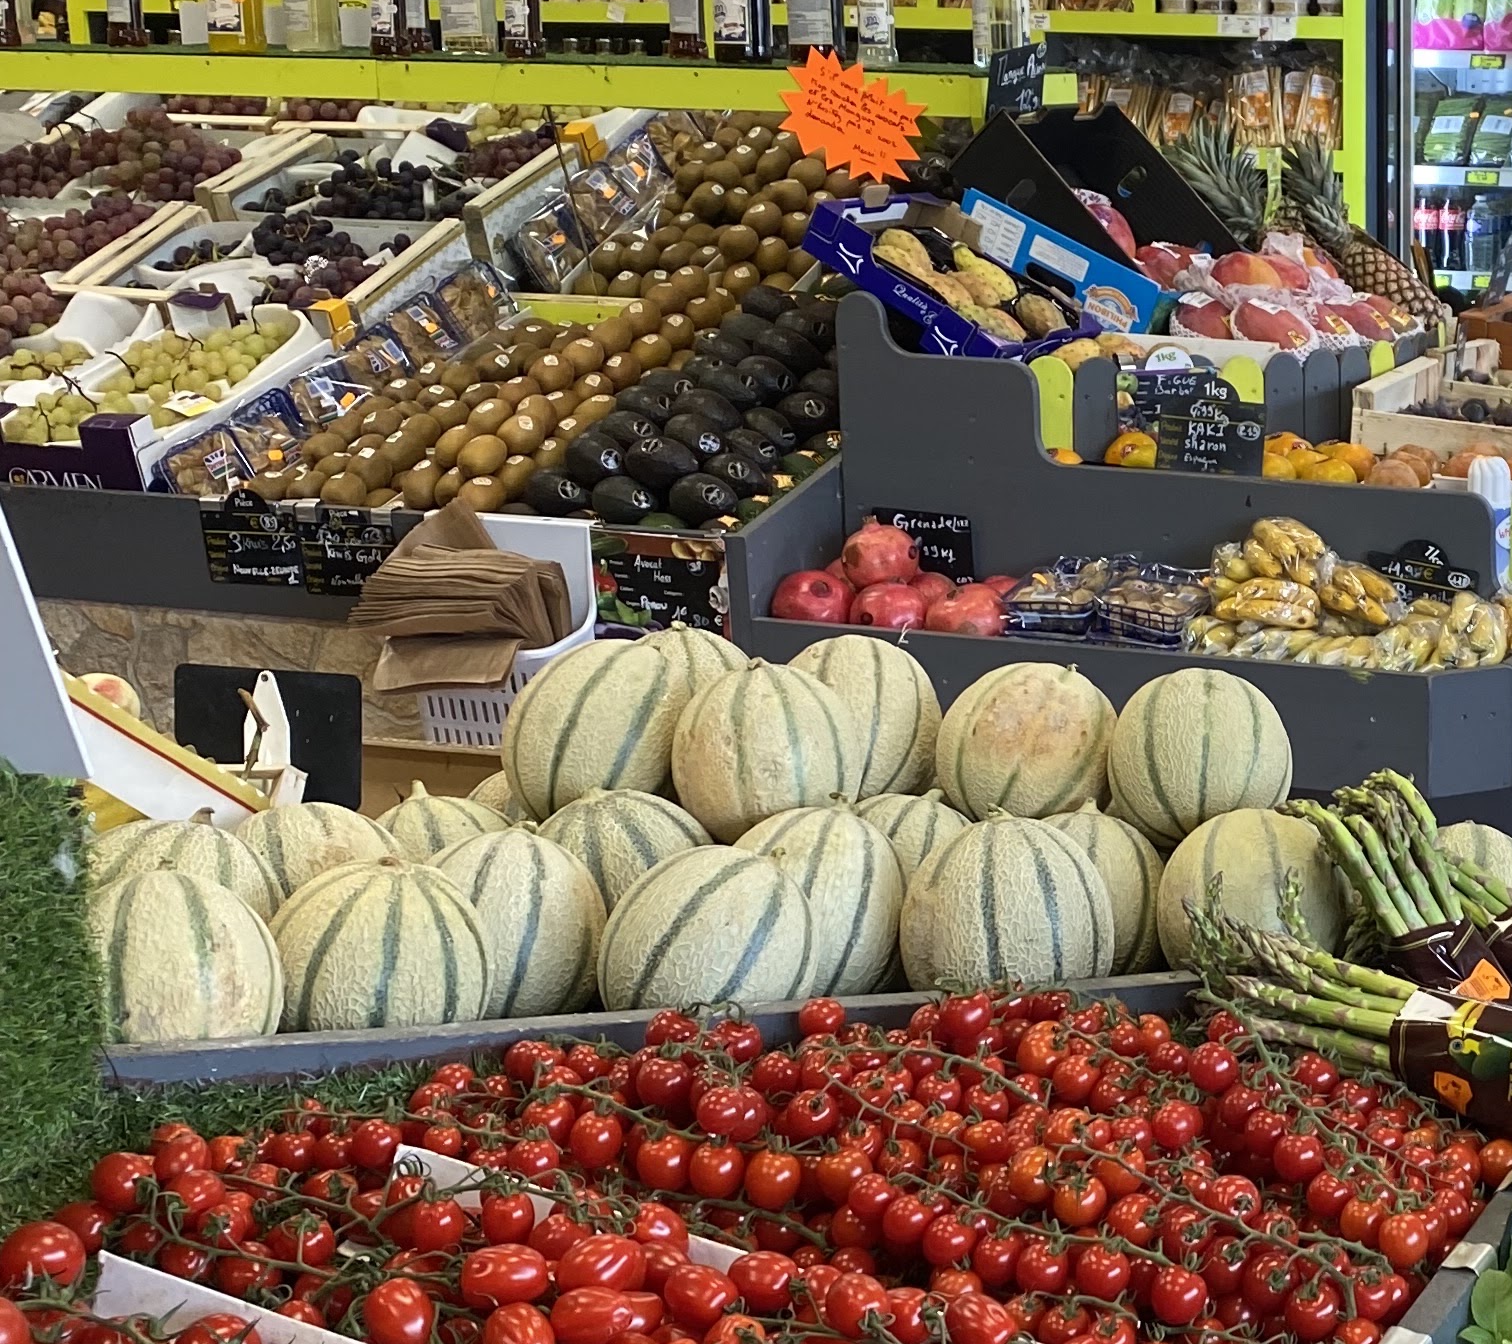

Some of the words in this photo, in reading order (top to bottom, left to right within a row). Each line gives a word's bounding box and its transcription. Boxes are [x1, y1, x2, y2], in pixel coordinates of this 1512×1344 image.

[1087, 301, 1128, 329] PHILIBON
[1155, 351, 1176, 362] 1kg
[1204, 381, 1228, 400] 1kg
[1188, 420, 1225, 437] KAKI
[1184, 438, 1227, 452] sharon
[228, 532, 243, 554] 3
[633, 554, 663, 572] Avocat
